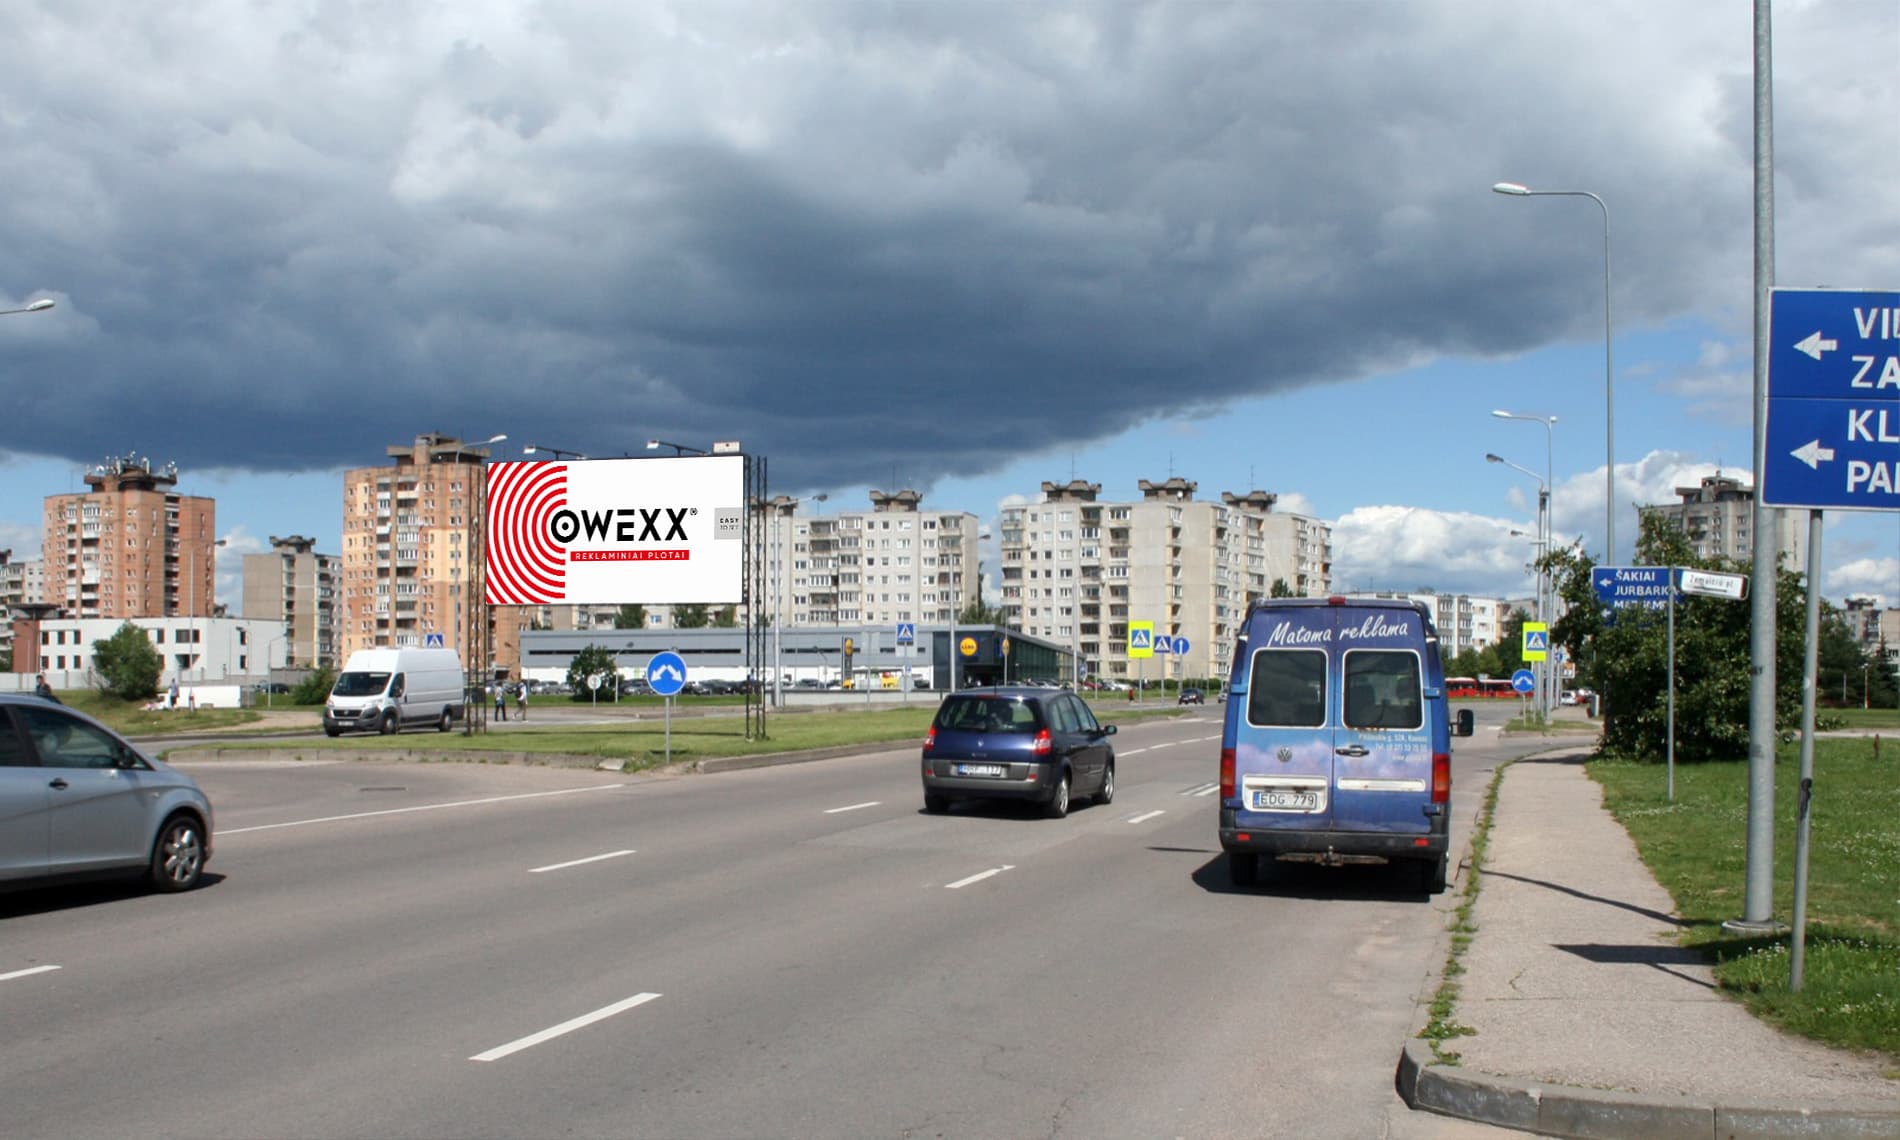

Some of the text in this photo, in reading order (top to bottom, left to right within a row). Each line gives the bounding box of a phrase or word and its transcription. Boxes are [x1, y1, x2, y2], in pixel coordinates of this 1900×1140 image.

[1853, 307, 1900, 340] VI
[1846, 461, 1900, 494] PA
[574, 550, 686, 561] REKLAMINIAI PLOTAI
[1614, 568, 1656, 582] ŠAKIAI
[1268, 614, 1409, 647] Matoma reklama
[1260, 792, 1315, 806] EDG 779
